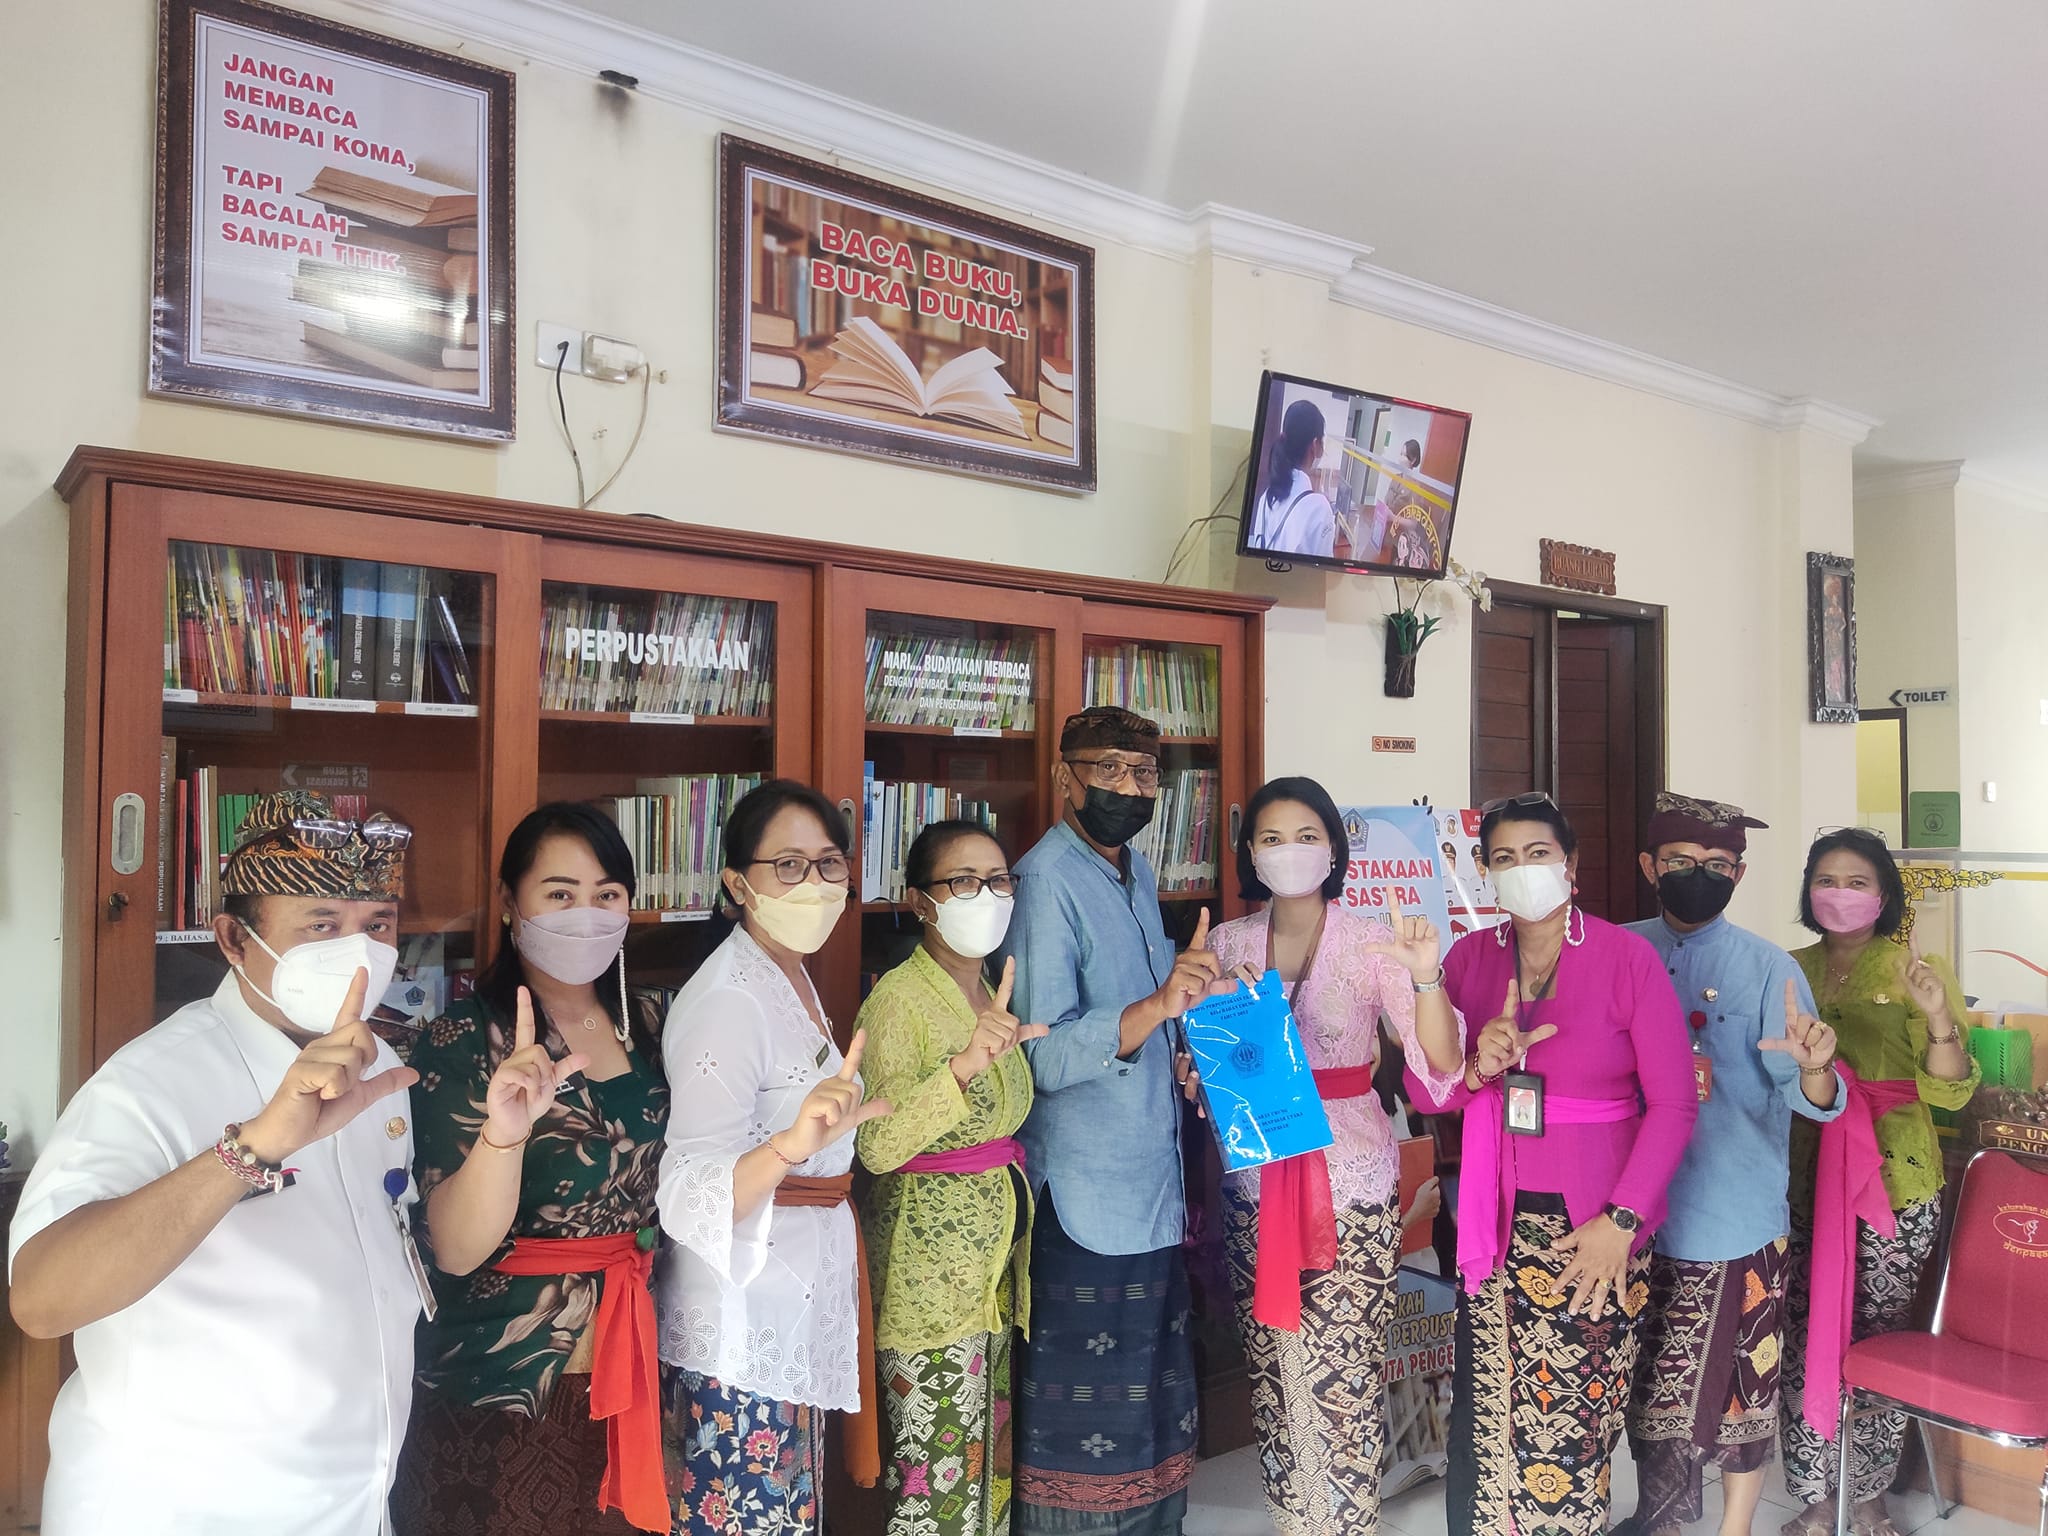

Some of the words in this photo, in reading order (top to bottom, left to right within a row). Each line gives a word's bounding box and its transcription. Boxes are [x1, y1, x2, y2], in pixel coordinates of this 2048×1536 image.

[224, 53, 334, 97] JANGAN
[224, 80, 359, 129] MEMBACA
[223, 109, 324, 148] SAMPAI
[334, 135, 415, 173] KOMA,
[222, 165, 282, 194] TAPI
[222, 194, 347, 236] BACALAH
[221, 224, 322, 257] SAMPAI
[333, 243, 406, 275] TITIK.
[822, 223, 915, 273] BACA
[925, 251, 1021, 305] BUKU,
[812, 260, 910, 310] BUKA
[918, 288, 1028, 339] DUNIA.
[565, 628, 750, 671] PERPUSTAKAAN
[925, 655, 982, 675] BUDAYAKAN
[984, 660, 1030, 679] MEMBACA
[884, 675, 913, 688] DENGAN
[957, 681, 996, 694] MENAMBAH
[997, 684, 1030, 696] WAWASAN
[920, 697, 933, 708] DAN
[935, 698, 982, 712] PENGETAHUAN
[983, 702, 997, 713] KITA
[1904, 691, 1946, 702] TOILET
[1383, 740, 1390, 749] NO
[1392, 740, 1414, 750] SMOKING
[1347, 860, 1433, 880] STAKAAN
